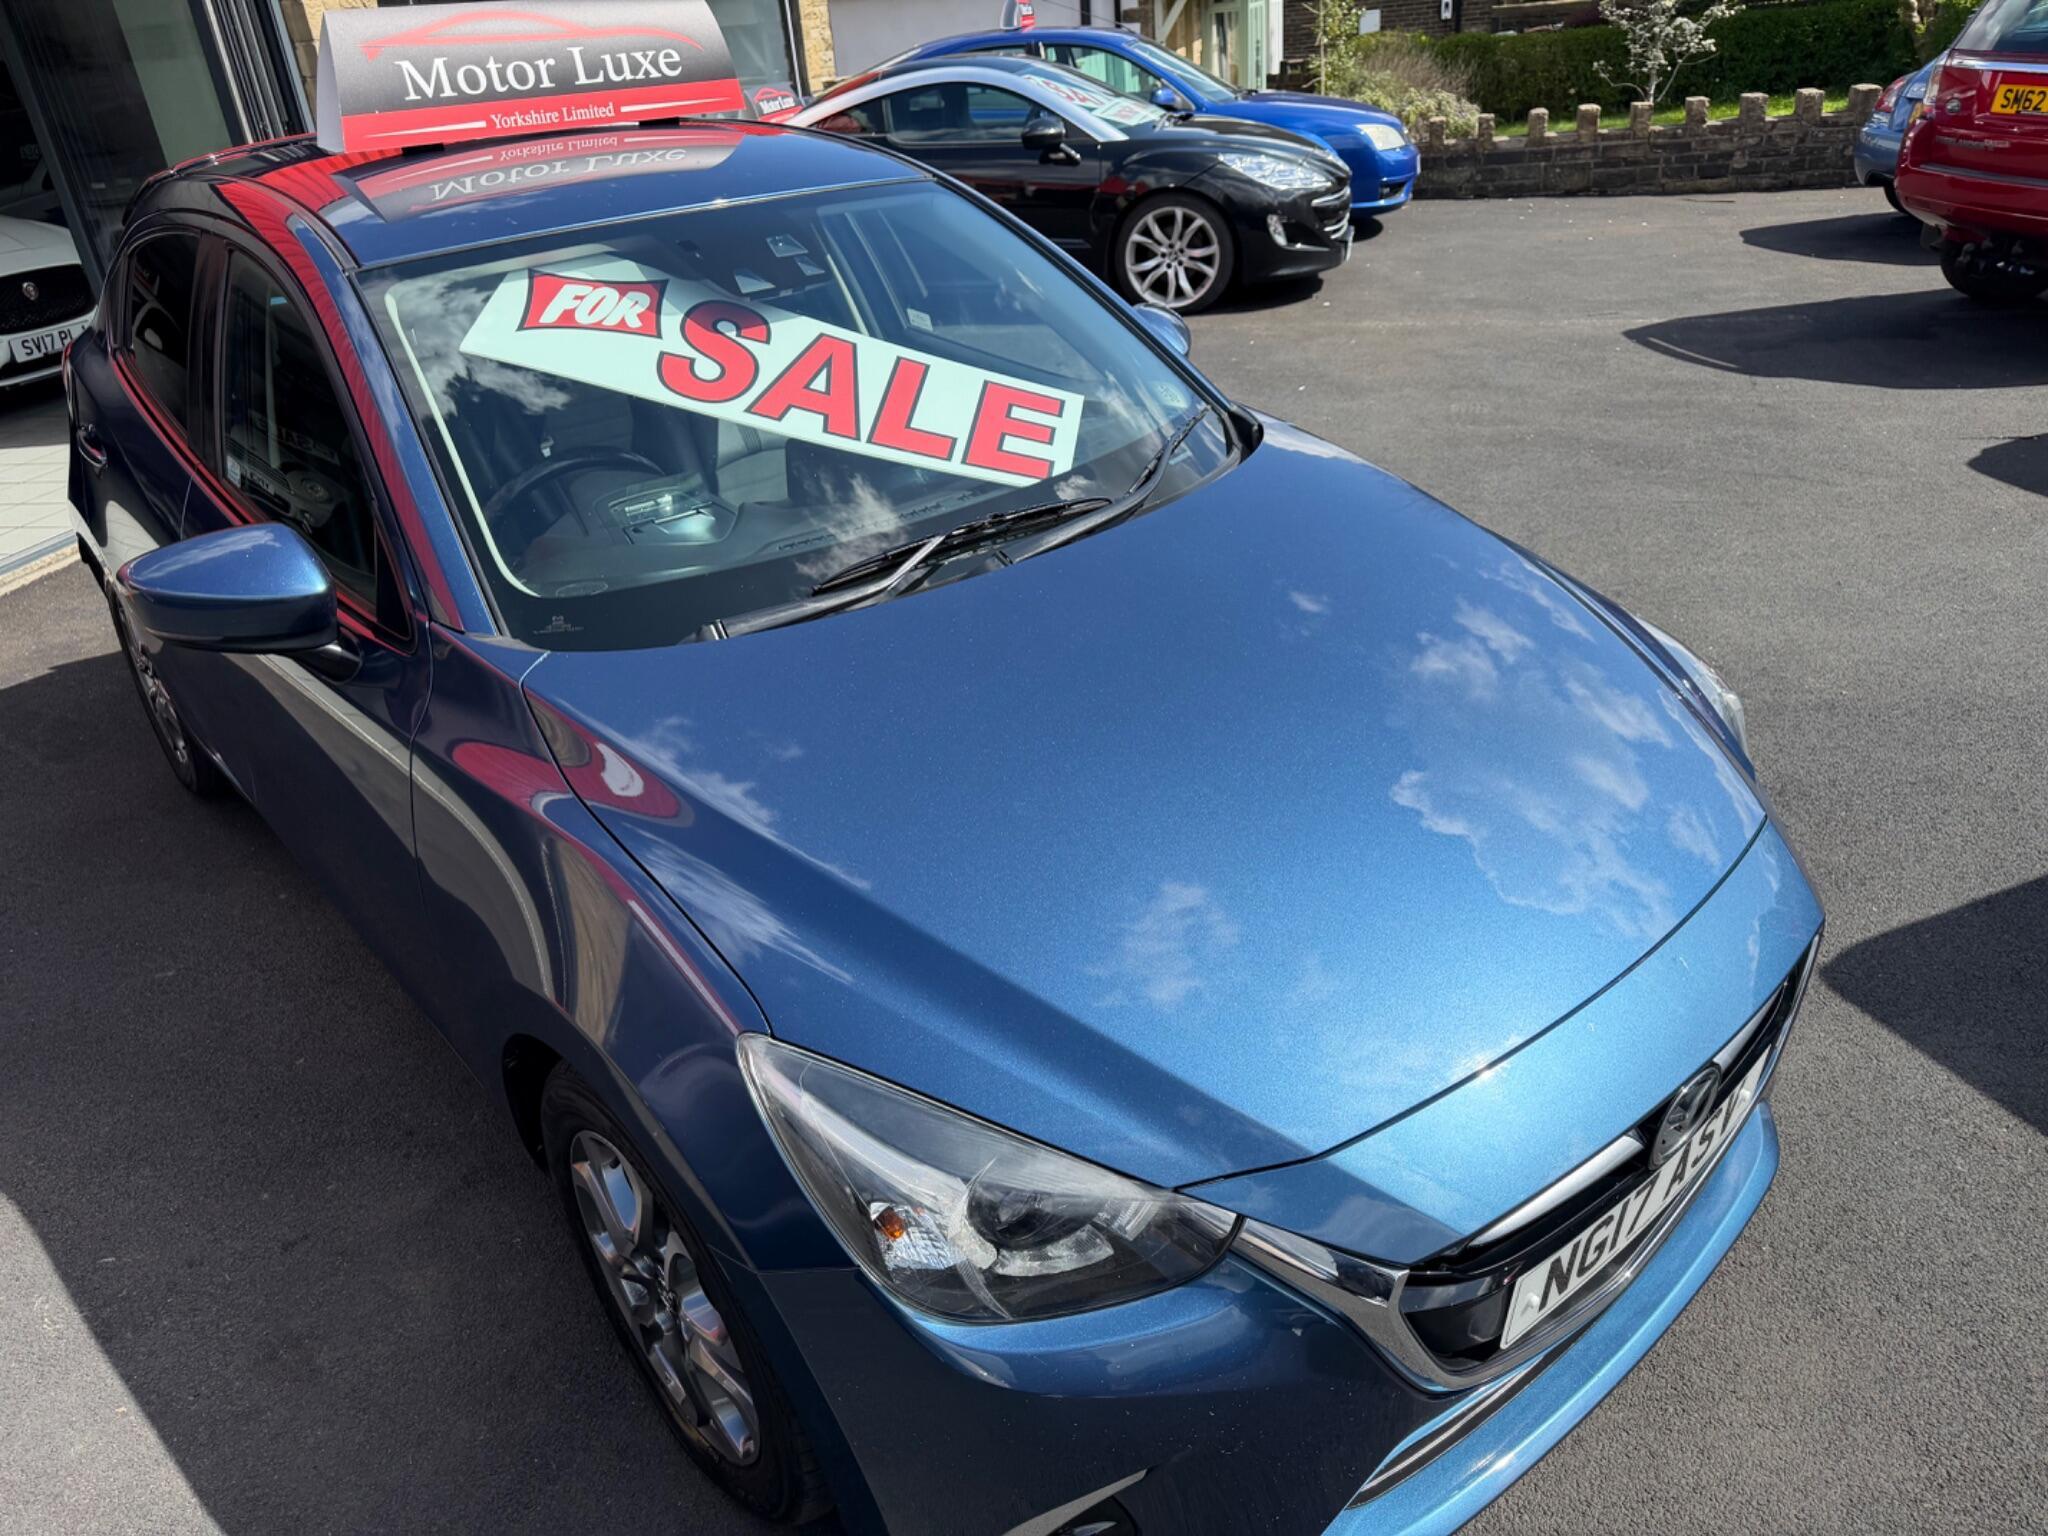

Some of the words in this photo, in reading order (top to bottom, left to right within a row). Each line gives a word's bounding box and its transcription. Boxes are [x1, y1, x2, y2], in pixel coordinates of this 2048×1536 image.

[394, 55, 556, 101] Motor
[566, 46, 683, 86] Luxe
[490, 108, 560, 130] Yorkshire
[562, 101, 615, 122] Limited
[2000, 88, 2047, 112] SM62
[538, 283, 651, 329] FOR
[21, 333, 55, 356] SV17
[656, 299, 1066, 481] SALE
[1538, 1170, 1662, 1313] NG17
[1663, 1078, 1747, 1201] ASV
